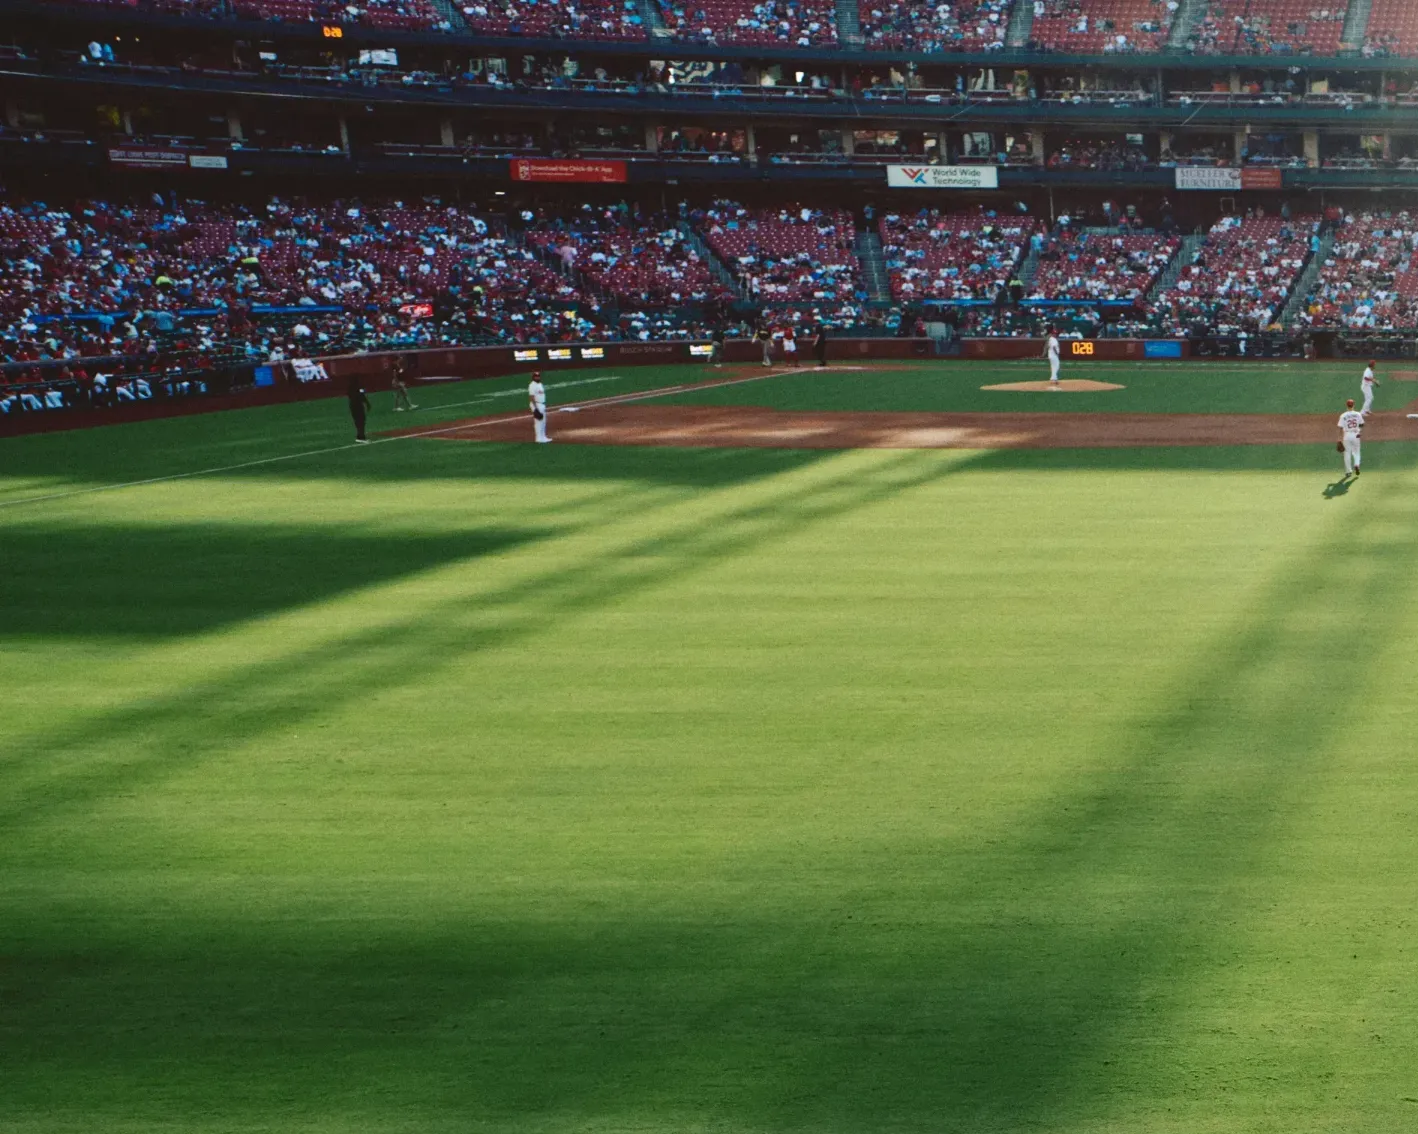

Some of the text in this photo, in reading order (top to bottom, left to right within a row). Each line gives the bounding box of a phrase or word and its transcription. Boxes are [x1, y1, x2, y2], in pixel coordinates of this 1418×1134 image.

[932, 168, 981, 176] World Wide
[932, 177, 981, 186] Technology
[1347, 420, 1358, 429] 26
